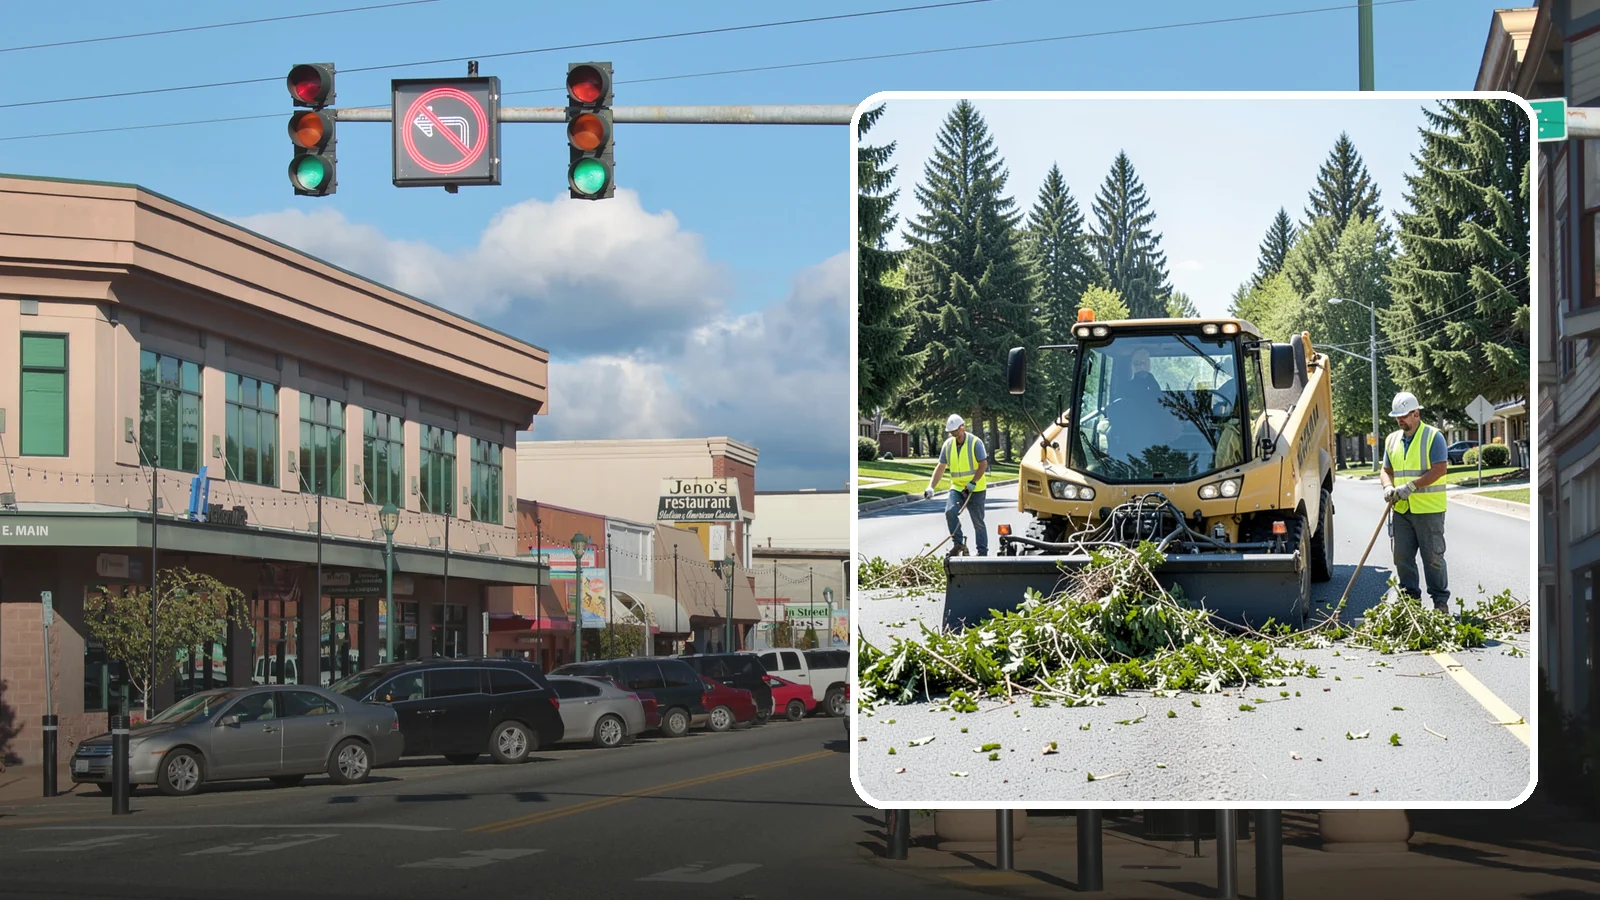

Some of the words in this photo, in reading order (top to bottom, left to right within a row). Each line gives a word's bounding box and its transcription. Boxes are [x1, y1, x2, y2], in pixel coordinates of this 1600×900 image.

[670, 480, 727, 494] Jeno's
[665, 496, 731, 509] restaurant
[658, 510, 681, 520] Italian
[686, 510, 714, 519] American
[715, 510, 737, 519] Cuisine
[2, 525, 13, 536] E.
[15, 525, 49, 536] MAIN
[797, 607, 828, 617] Street
